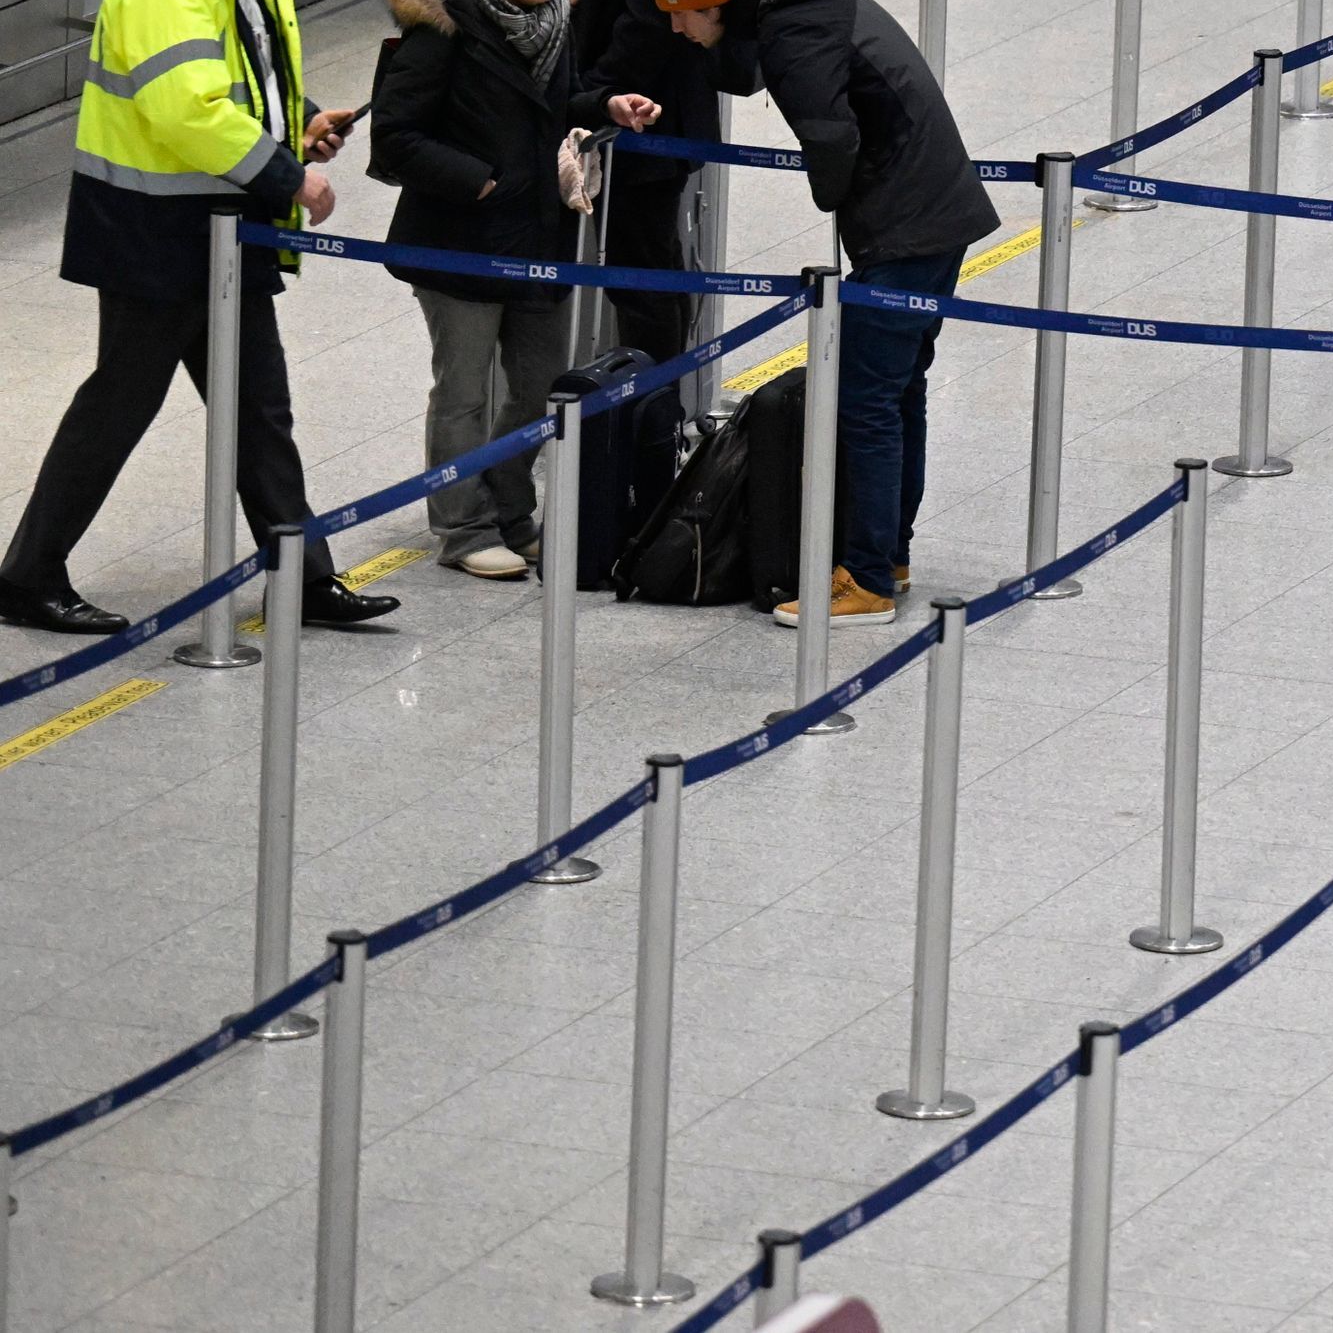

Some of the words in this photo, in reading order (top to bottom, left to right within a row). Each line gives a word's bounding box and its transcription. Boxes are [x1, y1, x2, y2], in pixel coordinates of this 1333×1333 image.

[775, 154, 802, 167] DUS
[980, 165, 1007, 178] DUS
[1130, 180, 1156, 195] DUS
[316, 239, 344, 254] DUS
[529, 265, 557, 280] DUS
[744, 279, 772, 293] DUS
[794, 292, 806, 310] DUS
[909, 295, 937, 312] DUS
[1127, 322, 1156, 337] DUS
[709, 340, 721, 357] DUS
[622, 380, 634, 397] DUS
[541, 420, 555, 436] DUS
[443, 466, 457, 482] DUS
[343, 508, 357, 525] DUS
[243, 559, 257, 577] DUS
